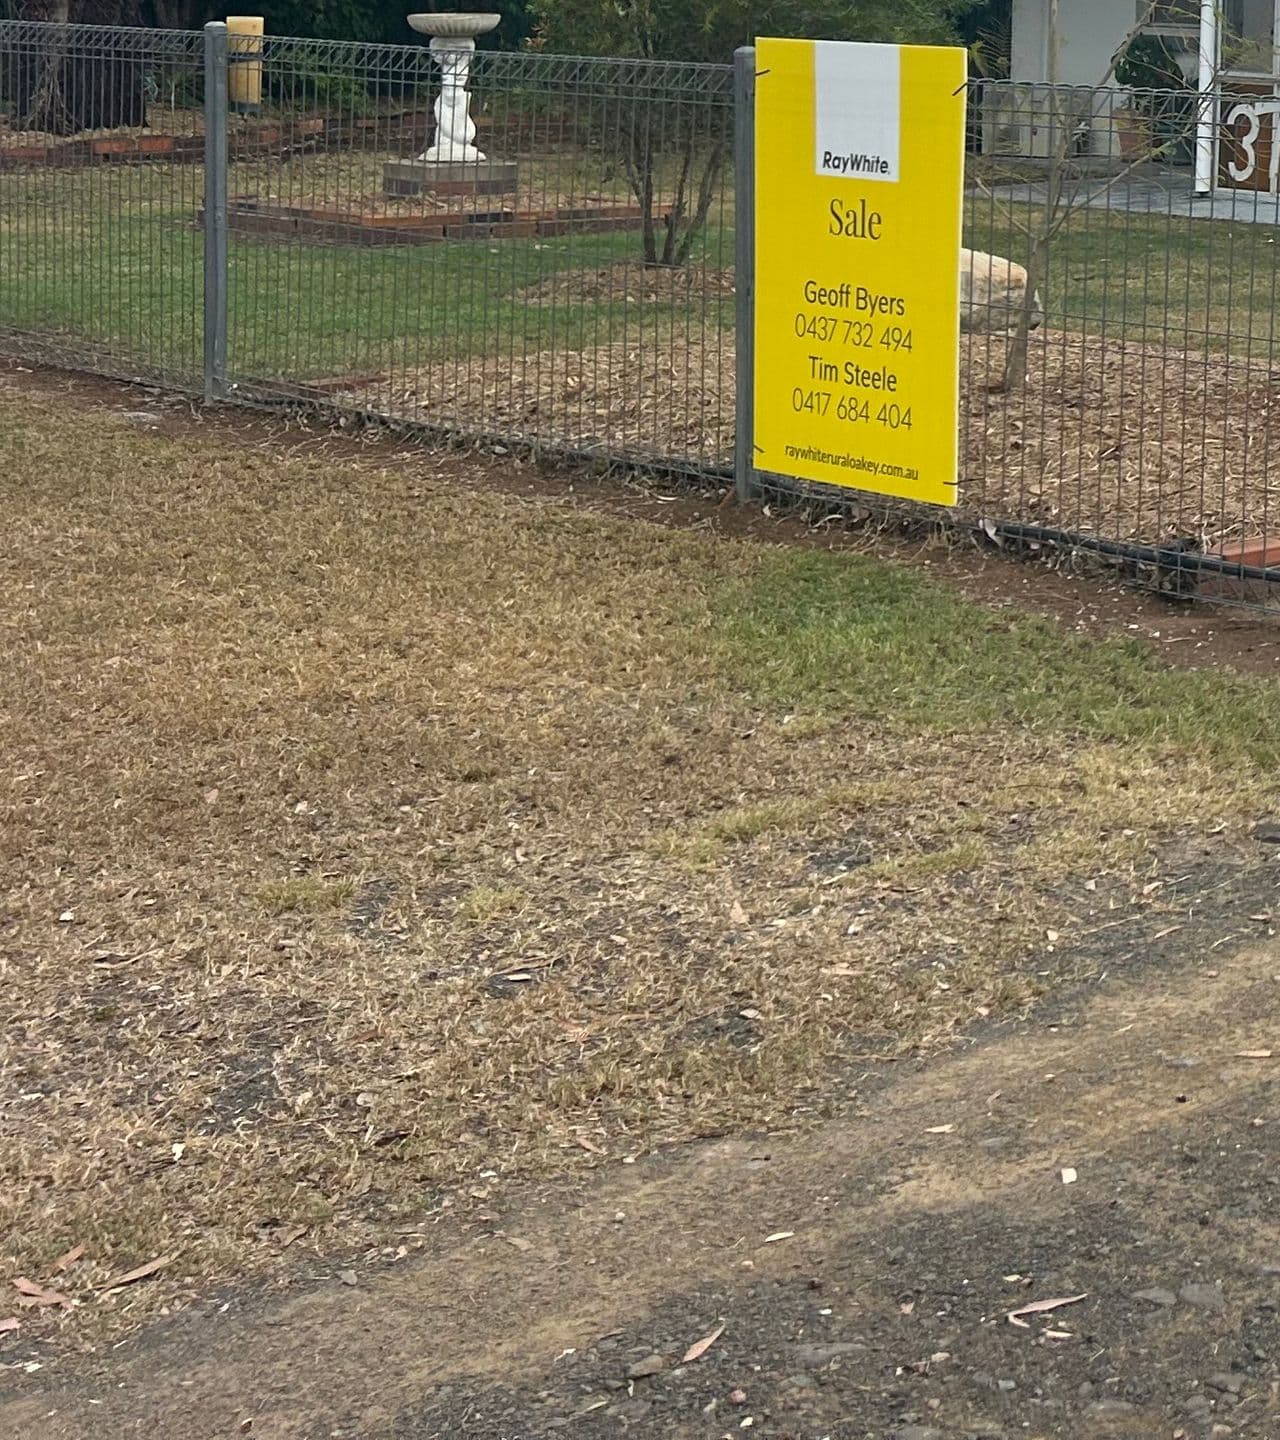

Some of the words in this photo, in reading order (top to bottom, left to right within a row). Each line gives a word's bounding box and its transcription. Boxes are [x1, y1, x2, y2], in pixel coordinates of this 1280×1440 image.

[829, 198, 882, 240] Sale
[804, 280, 851, 308] Geoff
[856, 287, 905, 317] Byers
[795, 313, 838, 342] 0437
[843, 320, 873, 348] 732
[880, 326, 913, 353] 494
[808, 355, 839, 382] Tim
[843, 361, 897, 392] Steele
[792, 387, 832, 417] 0417
[837, 395, 870, 424] 684
[877, 402, 913, 431] 404
[785, 445, 919, 480] raywhiteruraloakey.com.au
